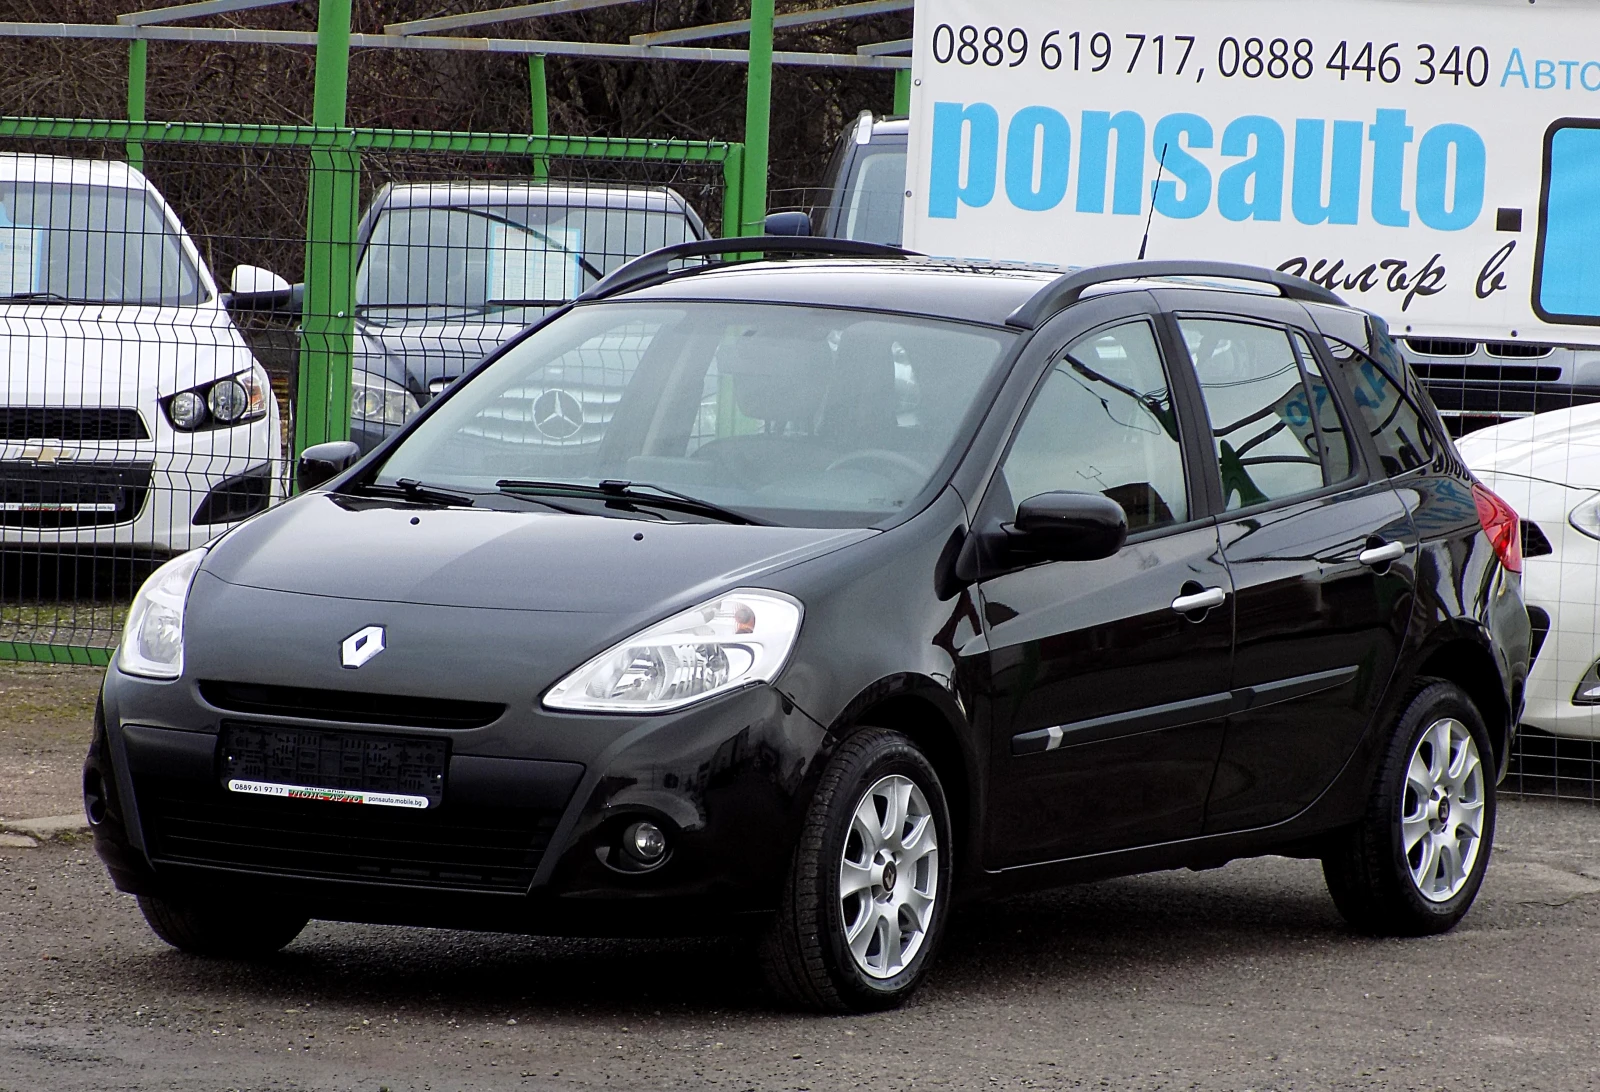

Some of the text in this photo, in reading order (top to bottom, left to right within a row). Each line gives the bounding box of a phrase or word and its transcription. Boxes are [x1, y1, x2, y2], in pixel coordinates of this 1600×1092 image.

[932, 23, 1028, 68] 0889
[1040, 29, 1112, 72] 619
[1125, 33, 1205, 83] 717,
[1218, 36, 1314, 79] 0888
[1326, 40, 1401, 84] 446
[1414, 43, 1489, 87] 340
[234, 783, 252, 791] 0889
[368, 796, 422, 806] ponsauto.mobile.bg
